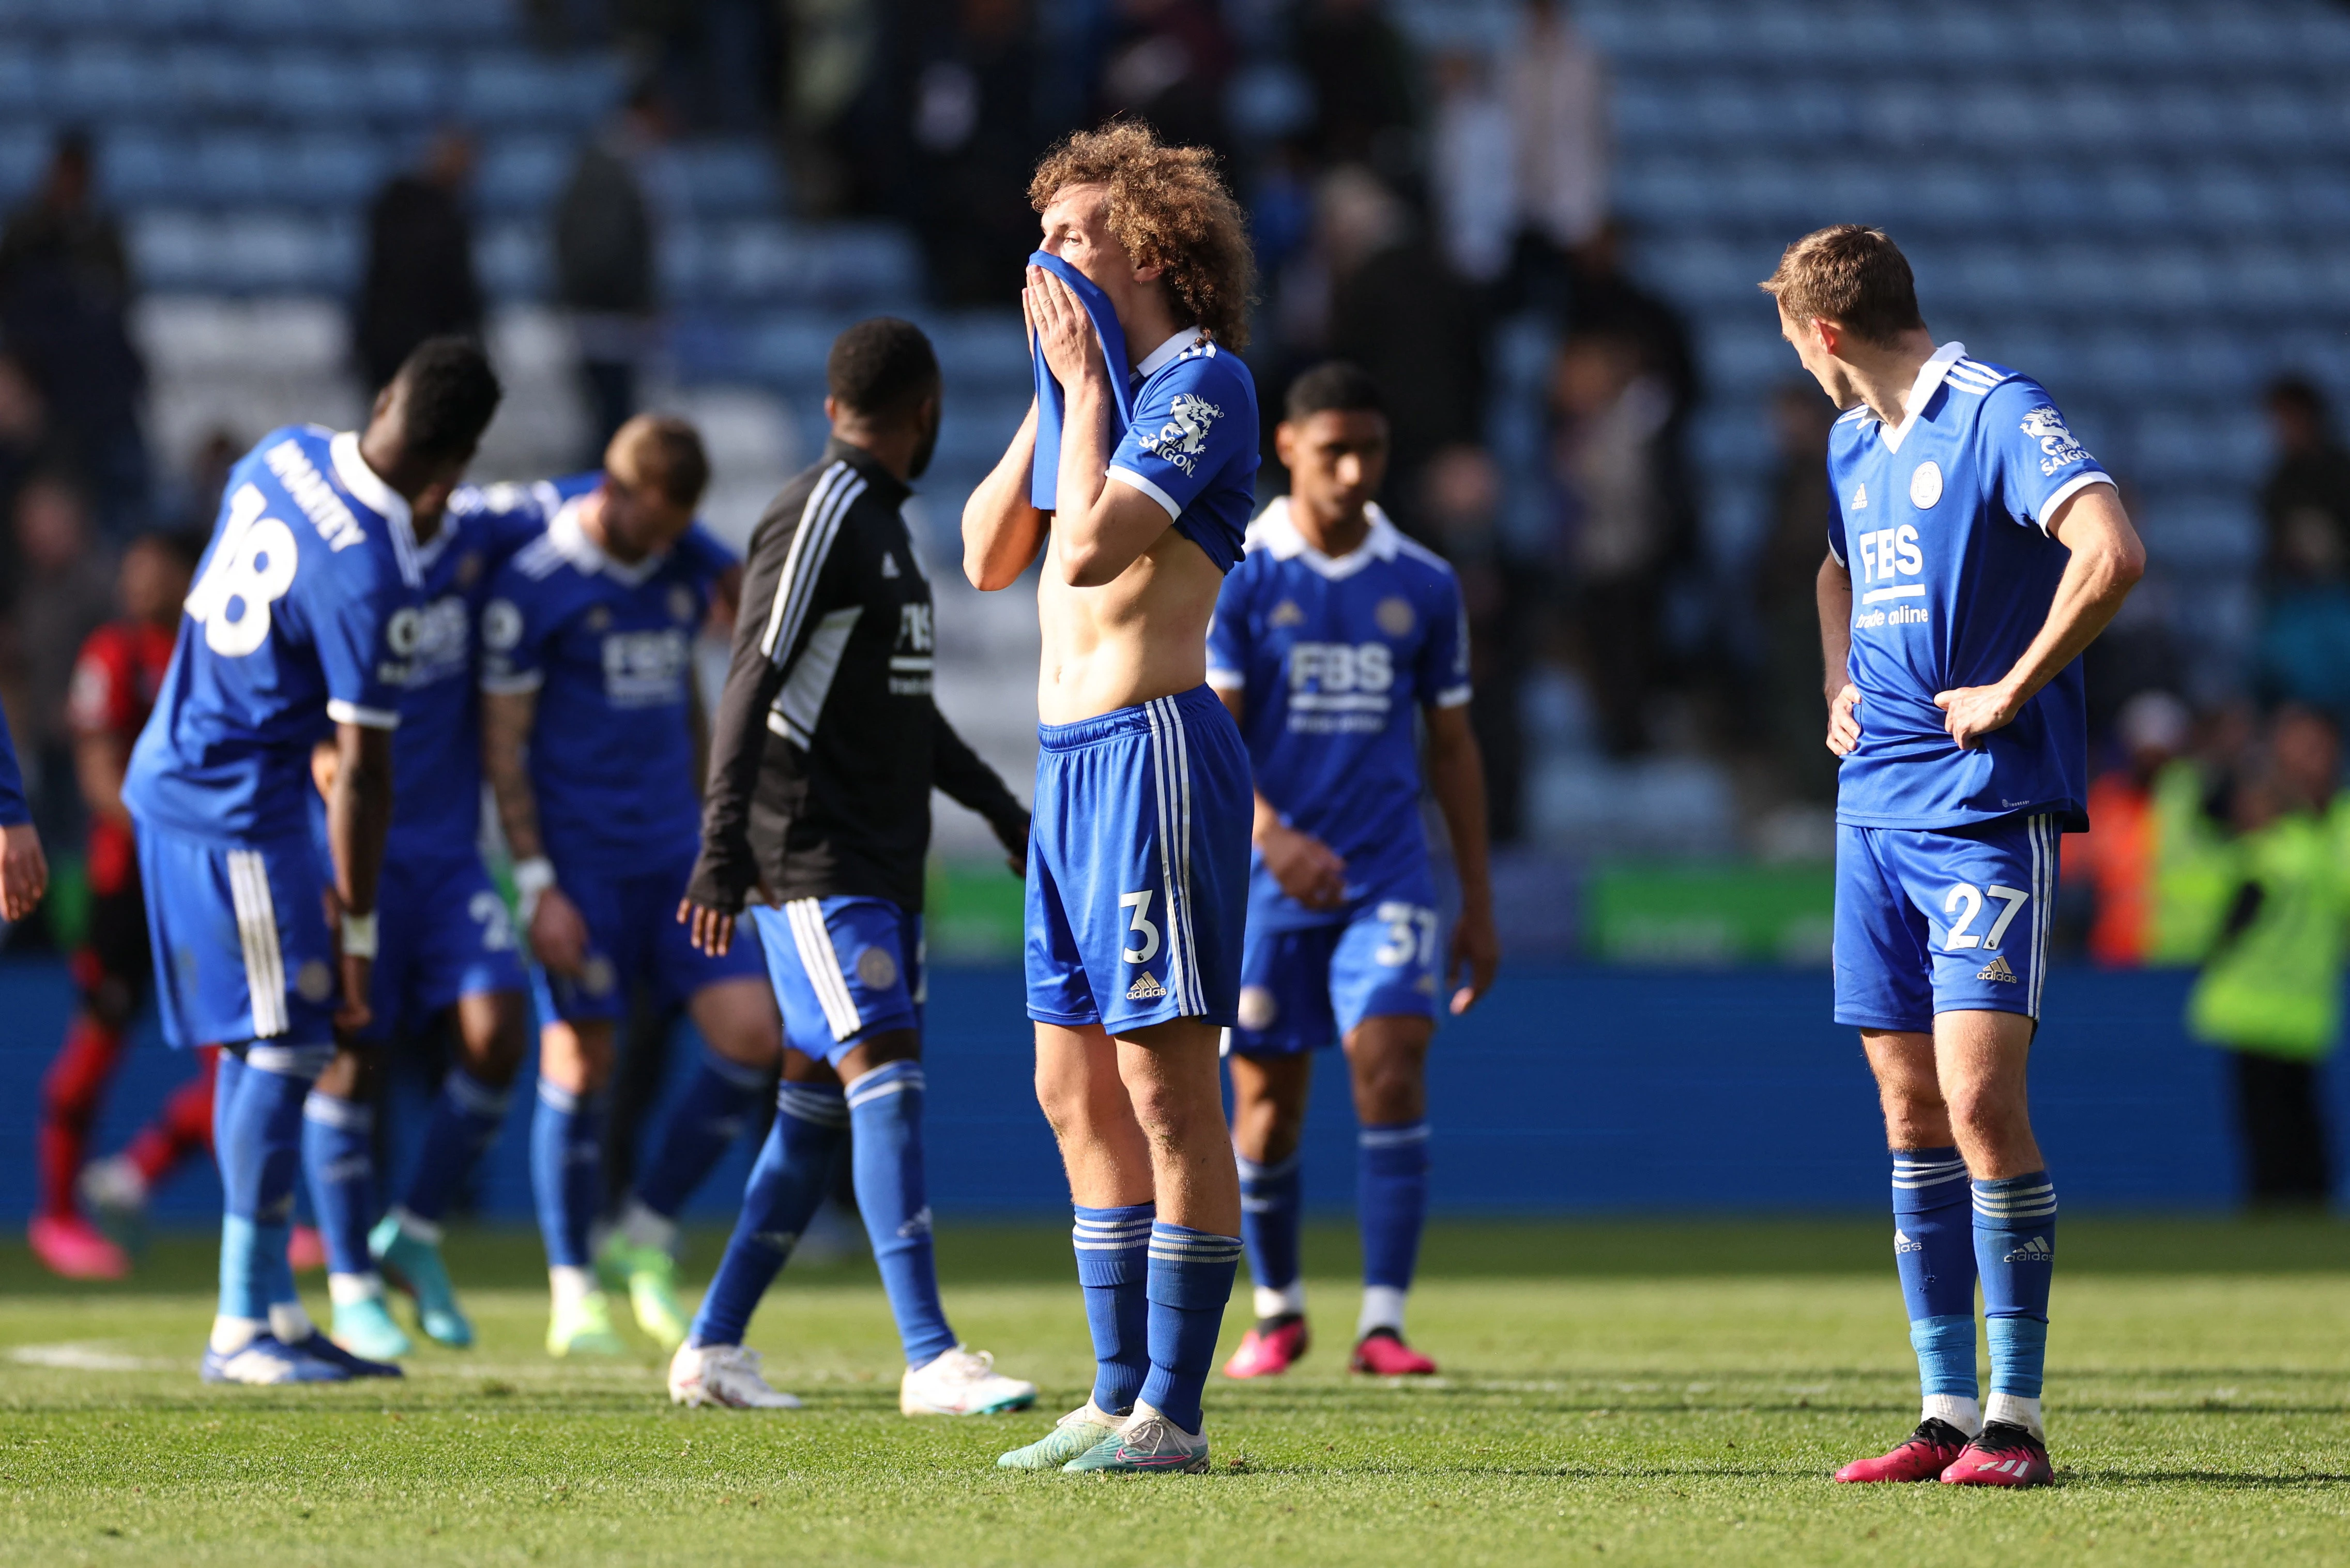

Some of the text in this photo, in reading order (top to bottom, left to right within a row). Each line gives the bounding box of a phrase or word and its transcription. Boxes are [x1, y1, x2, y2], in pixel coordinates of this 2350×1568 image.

[1139, 436, 1196, 477] SAIGON
[1165, 436, 1184, 452] BIA
[184, 482, 298, 657] 18
[1859, 524, 1923, 584] FBS
[1888, 605, 1929, 626] online
[1289, 642, 1394, 693] FBS
[1120, 889, 1159, 964] 3
[1375, 901, 1439, 968] 31
[1944, 882, 2029, 951] 27
[1126, 987, 1167, 1000] adidas
[1976, 969, 2017, 984] adidas
[2004, 1251, 2054, 1262] adidas
